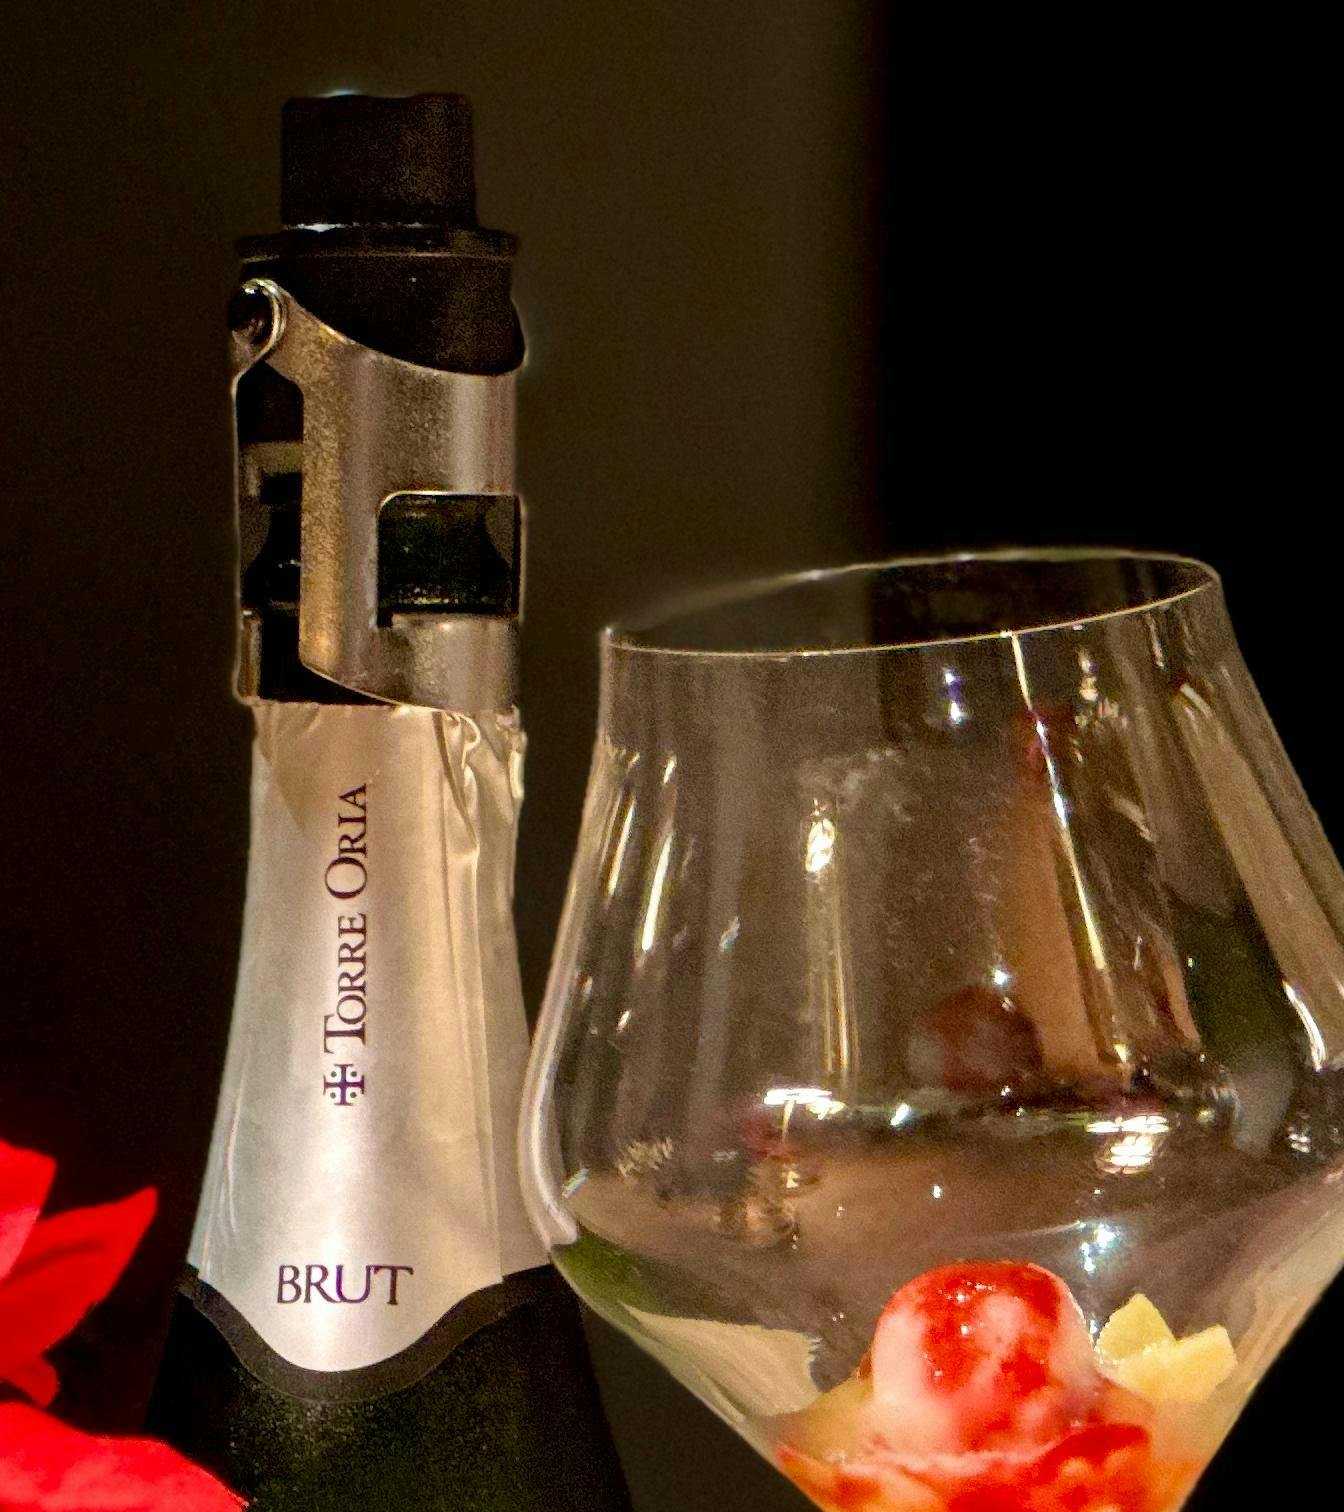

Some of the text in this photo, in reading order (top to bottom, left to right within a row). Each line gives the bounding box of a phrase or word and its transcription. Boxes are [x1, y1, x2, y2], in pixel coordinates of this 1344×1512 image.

[324, 783, 368, 1055] TORRE ORIA
[276, 1265, 414, 1306] BRUT
